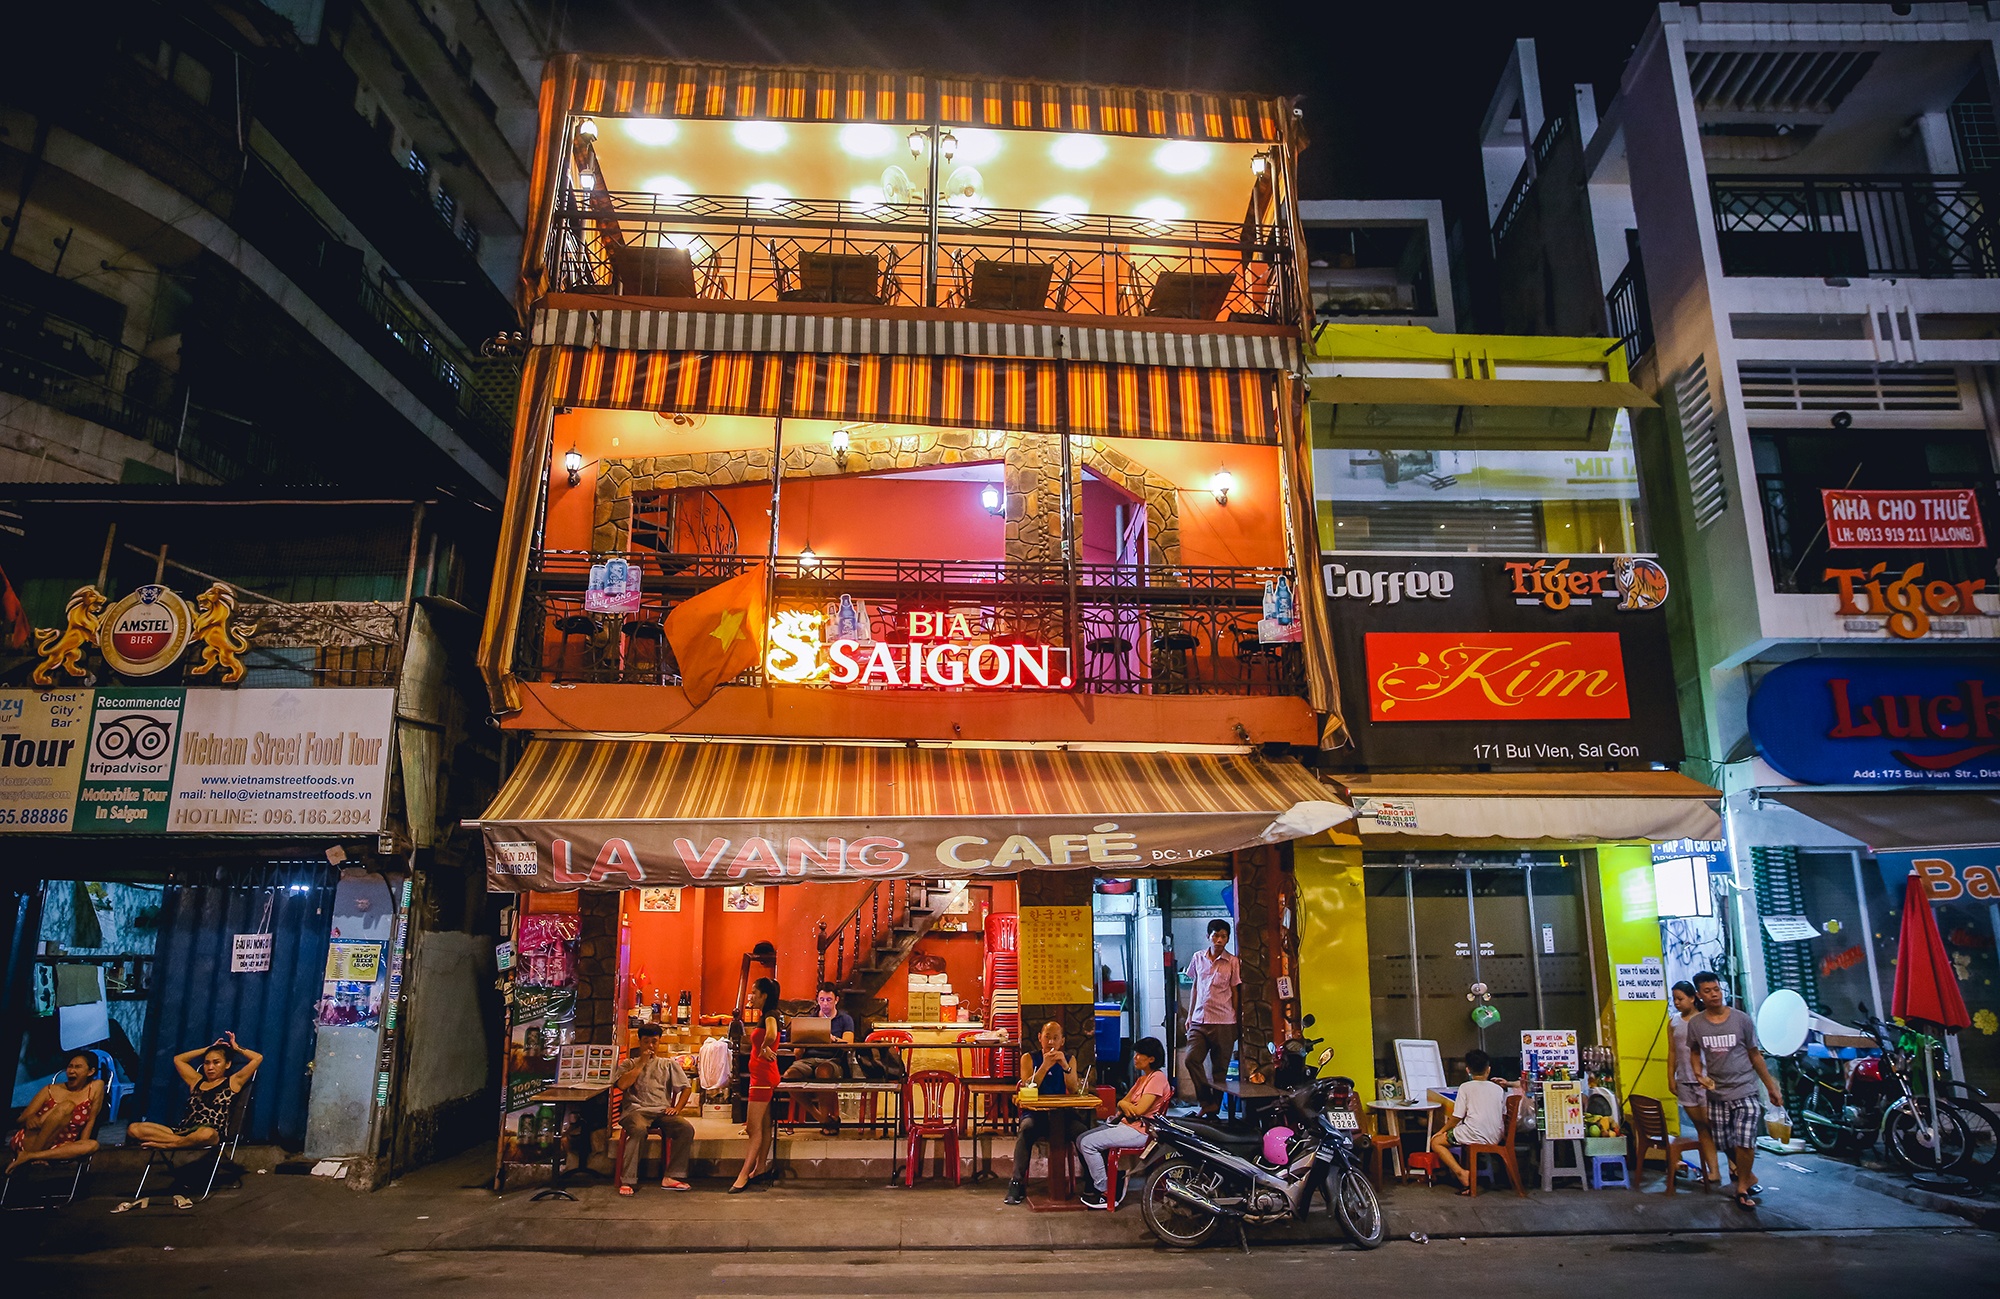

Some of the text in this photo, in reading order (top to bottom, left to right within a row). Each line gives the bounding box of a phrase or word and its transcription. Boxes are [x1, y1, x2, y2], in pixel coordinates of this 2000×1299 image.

[1832, 494, 1971, 521] NHÀ CHO THUÊ
[1837, 528, 1854, 542] LH:
[1857, 527, 1882, 542] 0913
[1886, 527, 1905, 542] 919
[1908, 527, 1927, 542] 211
[1323, 563, 1454, 606] Coffee
[1504, 559, 1608, 611] Tiger
[1824, 562, 1986, 639] Tiger
[119, 620, 168, 631] AMSTEL
[908, 611, 972, 640] BIA
[130, 635, 153, 644] BIER
[1377, 641, 1618, 723] Kim
[40, 693, 76, 702] Ghost
[97, 696, 181, 708] Recommended
[50, 705, 74, 717] City
[51, 718, 72, 728] Bar
[0, 733, 75, 768] Tour
[182, 731, 383, 766] Vietnam Street Food Tour
[1473, 745, 1499, 759] 171
[1506, 744, 1531, 759] Bui
[1578, 743, 1603, 758] Sai
[1608, 743, 1639, 758] Gon
[90, 762, 163, 775] tripadvisor
[1853, 769, 1881, 778] Add:
[1882, 769, 1901, 778] 175
[1904, 769, 1923, 778] Bui
[201, 774, 355, 785] www.vietnamstreetfoods.vn
[81, 787, 168, 802] Motorbike Tour
[179, 789, 372, 801] mail: hello@vietnamstreetfoods.vn
[95, 805, 148, 823] In Saigon
[175, 808, 371, 825] HOTLINE: 096.186.2894
[552, 838, 646, 884] LA
[673, 837, 909, 880] VANG
[936, 822, 1142, 868] CAFÉ
[1029, 909, 1082, 921] 한국식당
[1702, 1034, 1736, 1048] PUMA
